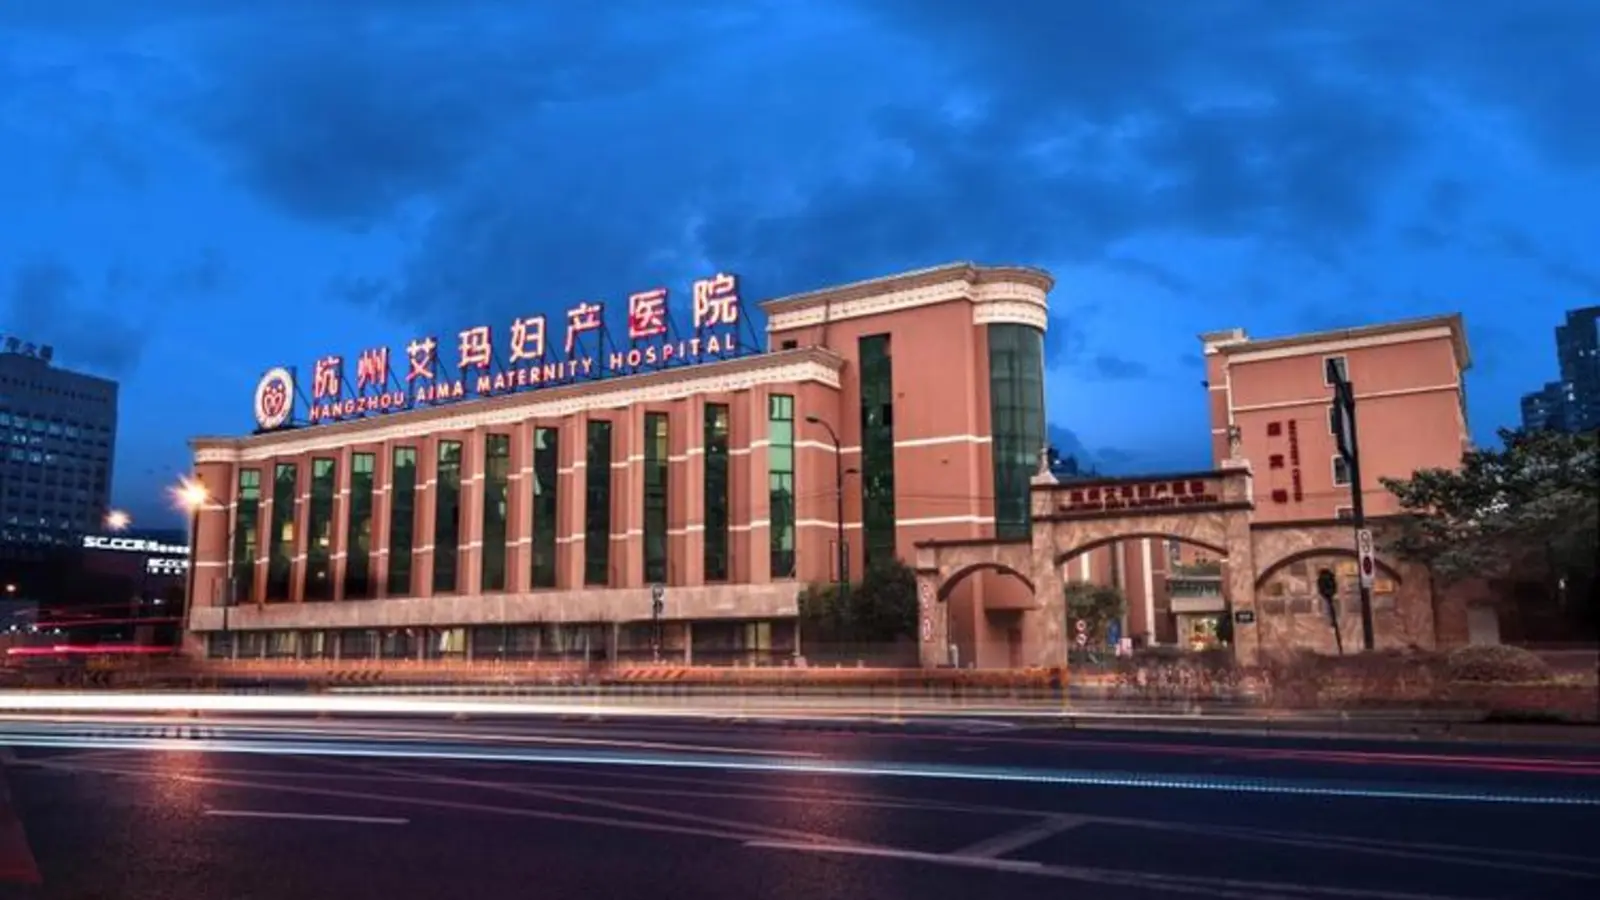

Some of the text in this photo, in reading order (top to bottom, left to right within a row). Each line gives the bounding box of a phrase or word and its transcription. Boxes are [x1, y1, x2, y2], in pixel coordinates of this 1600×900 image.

[310, 333, 736, 421] HANGZHOU AIMA MATERNITY HOSPITAL
[313, 273, 738, 398] 杭州艾玛妇产医院
